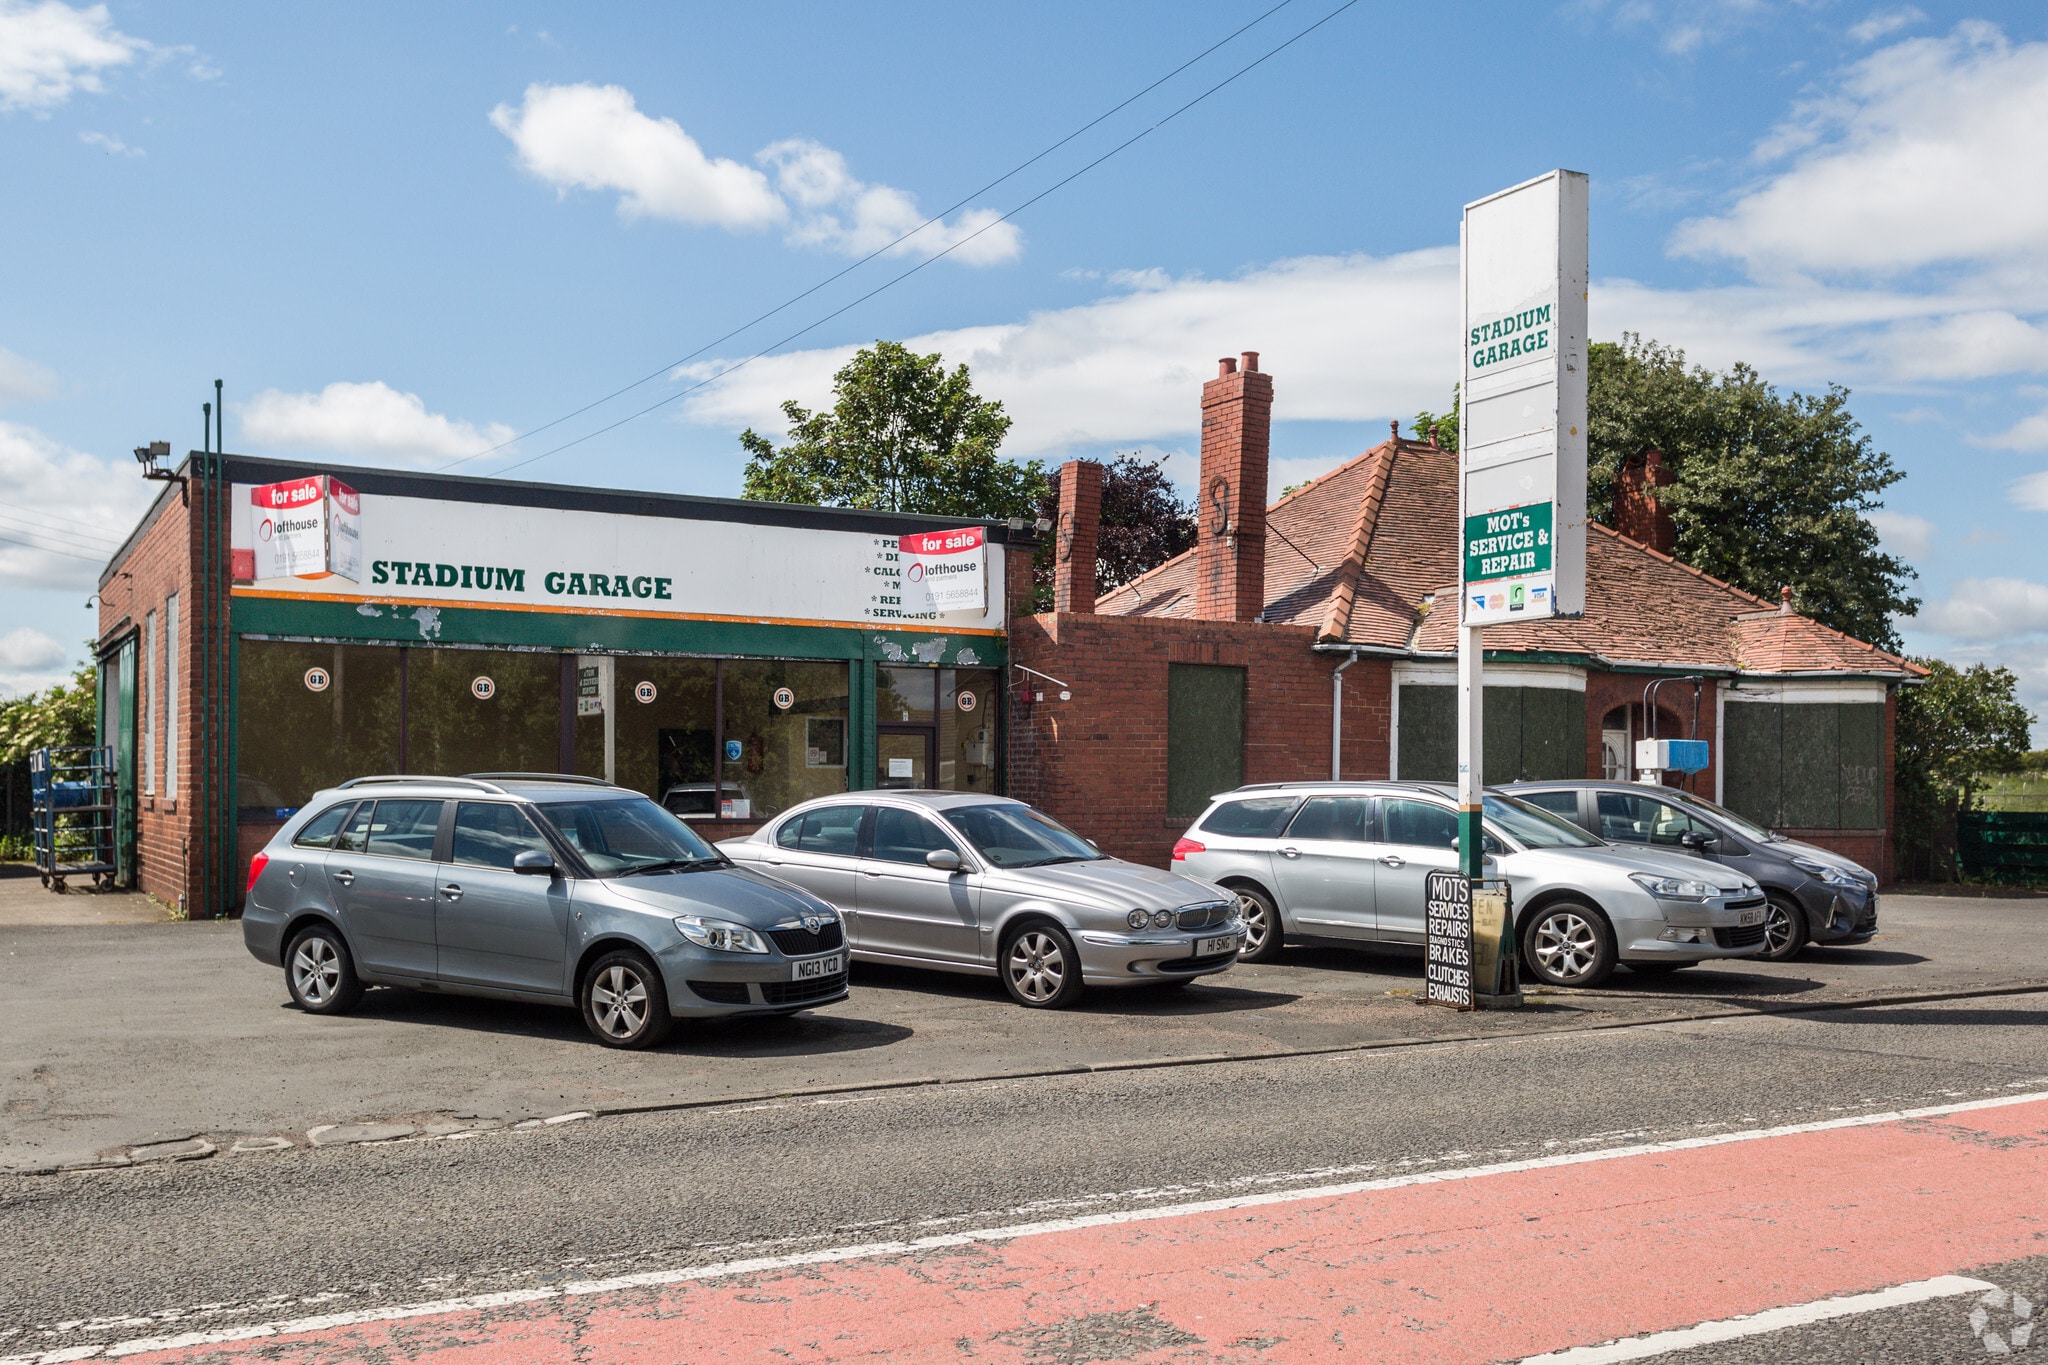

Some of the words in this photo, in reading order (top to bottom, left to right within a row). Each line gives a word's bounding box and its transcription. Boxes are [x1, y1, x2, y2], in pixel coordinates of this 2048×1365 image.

[1470, 303, 1551, 347] STADIUM
[1473, 329, 1548, 368] GARAGE
[271, 488, 289, 505] for
[291, 484, 317, 503] sale
[273, 518, 318, 534] lofthouse
[1486, 512, 1530, 534] MOT's
[922, 538, 942, 552] for
[945, 533, 975, 549] sale
[1469, 530, 1534, 557] SERVICE
[1537, 528, 1549, 546] &
[925, 562, 977, 576] lofthouse
[1481, 551, 1536, 575] REPAIR
[371, 560, 525, 592] STADIUM
[544, 571, 672, 600] GARAGE
[925, 591, 943, 601] 0191
[310, 675, 325, 685] GB
[476, 683, 490, 693] GB
[640, 688, 652, 697] GB
[778, 694, 790, 703] GB
[961, 697, 972, 706] GB
[1432, 877, 1469, 902] MOTS
[1428, 900, 1469, 920] SERVICES
[1428, 919, 1468, 938] REPAIRS
[1216, 937, 1230, 951] SNG
[1429, 935, 1465, 949] DIAGNOSTICS
[1429, 944, 1469, 966] BRAKES
[798, 961, 820, 978] NG13
[823, 957, 838, 974] YCD
[1428, 964, 1470, 987] CLUTCHES
[1428, 982, 1470, 1005] EXHAUSTS
